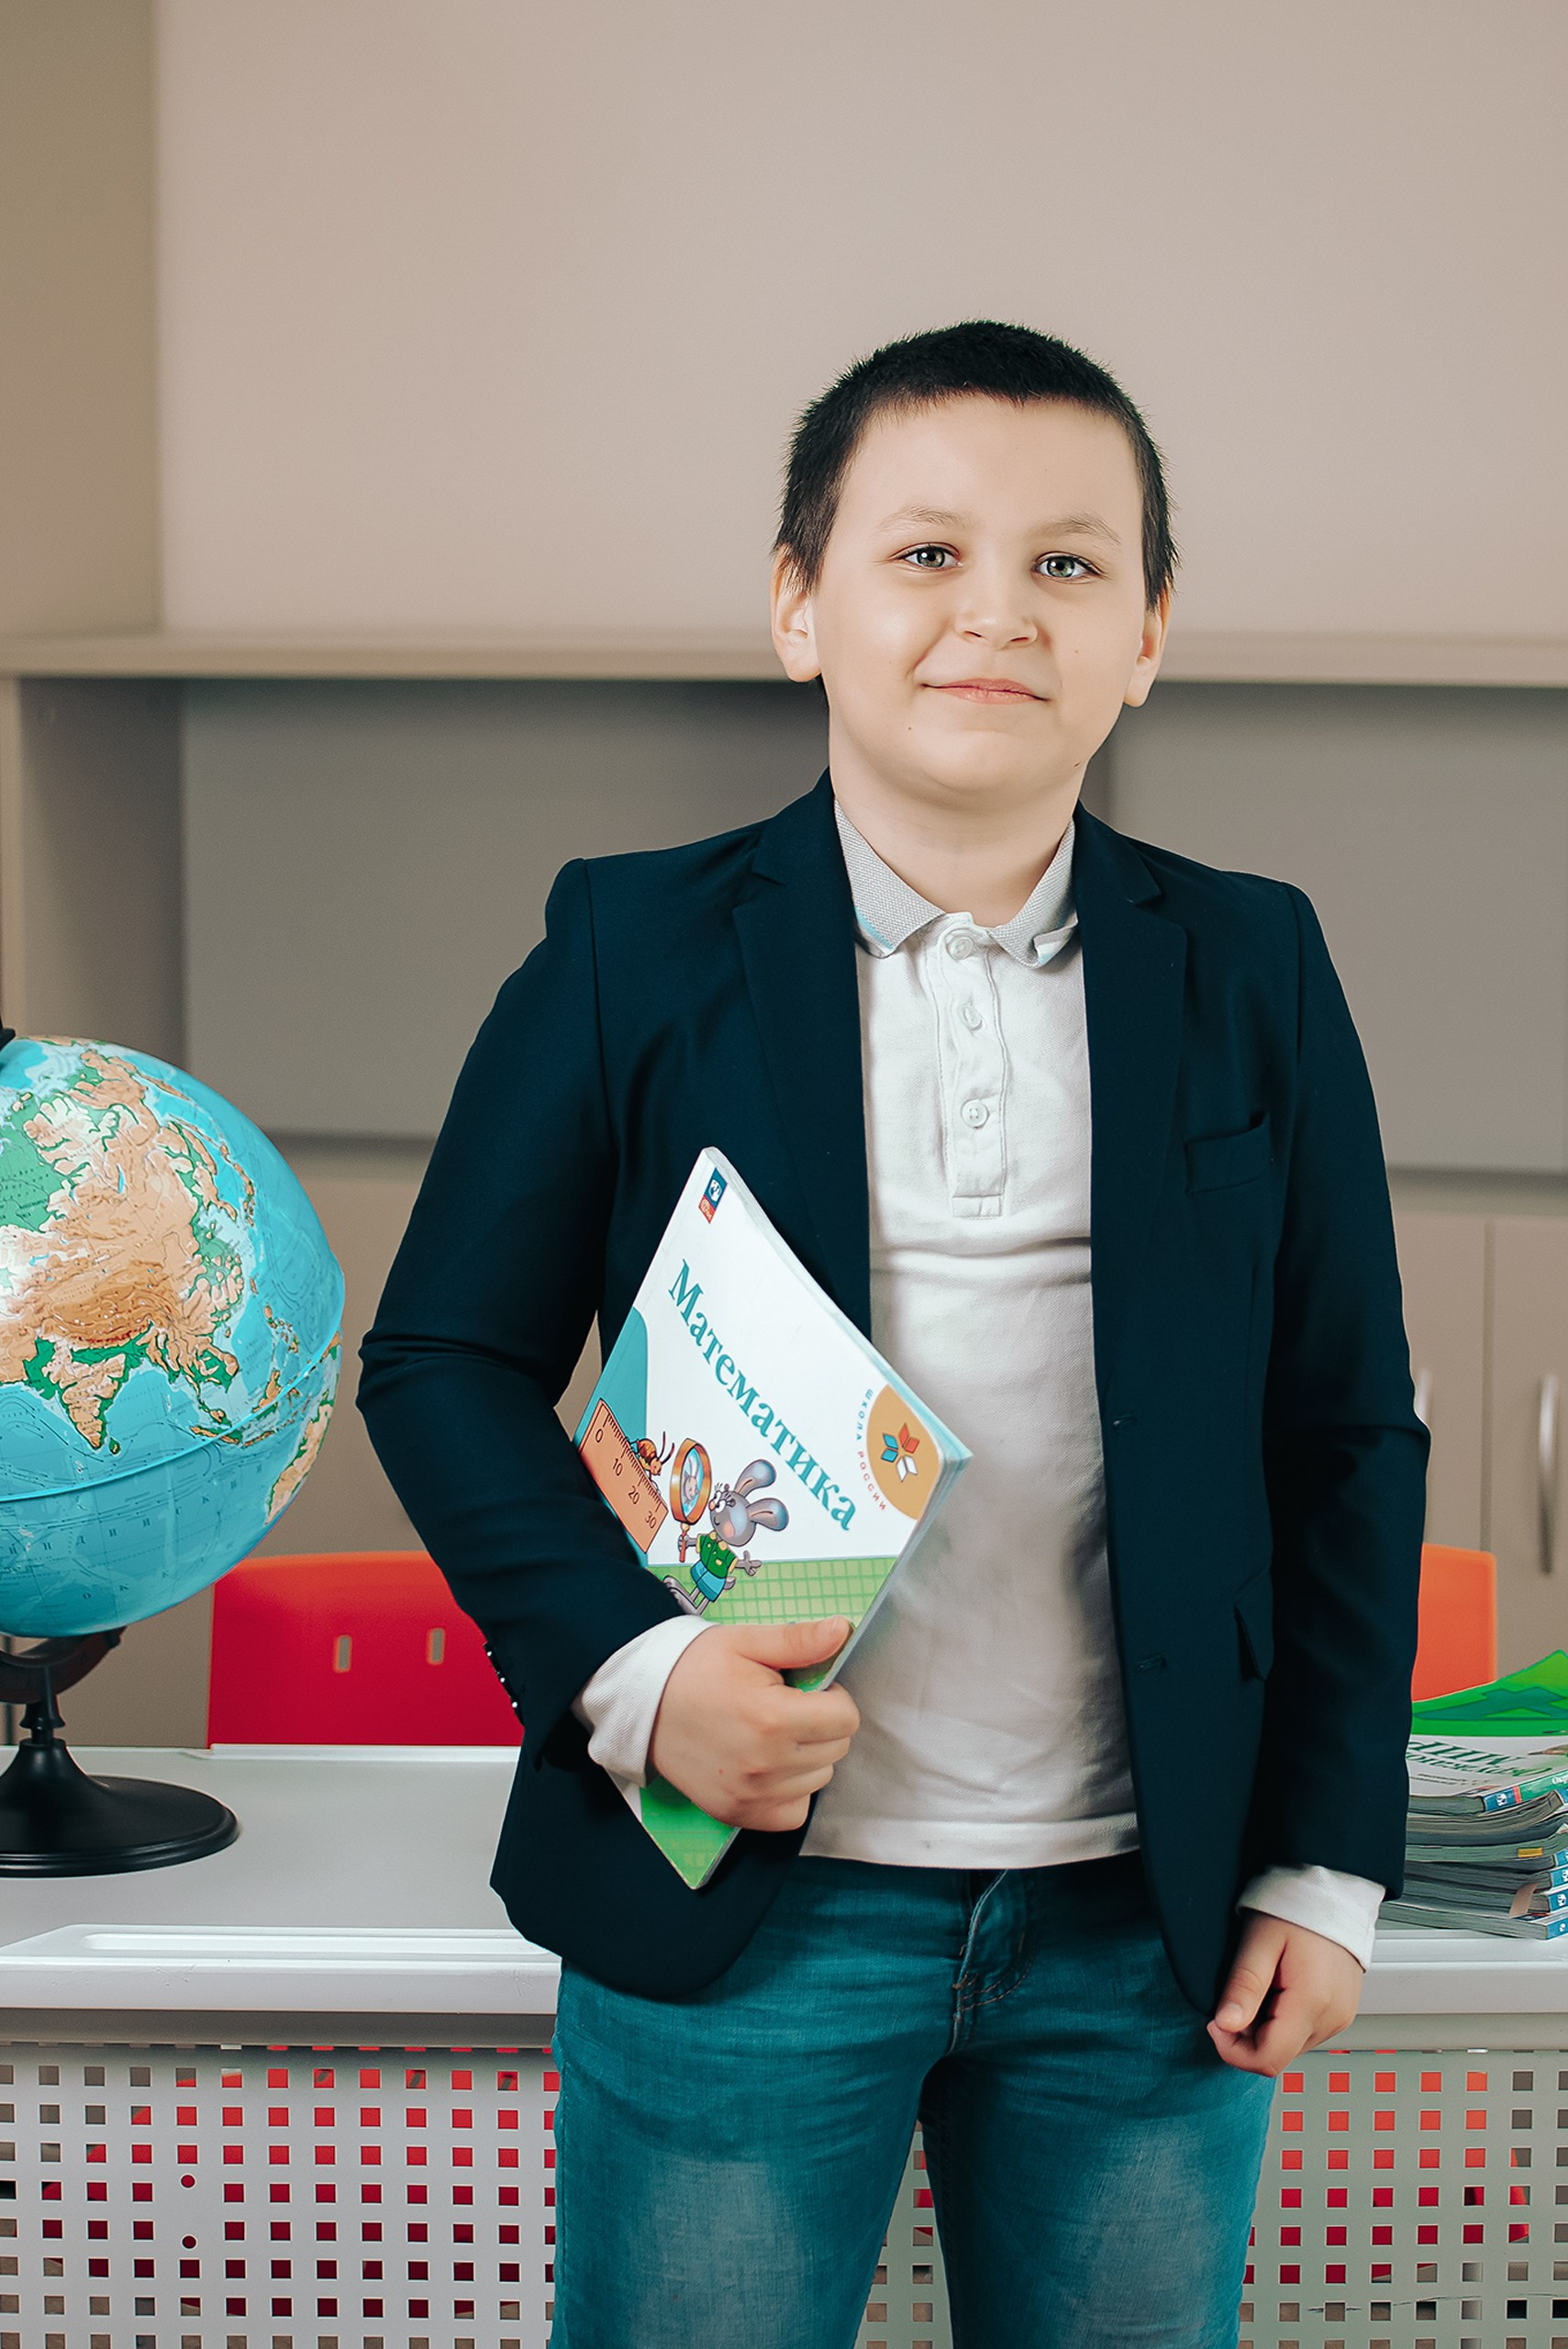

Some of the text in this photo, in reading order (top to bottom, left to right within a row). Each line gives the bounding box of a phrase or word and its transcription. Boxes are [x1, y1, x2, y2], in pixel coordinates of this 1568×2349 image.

[667, 1258, 857, 1531] Математика
[856, 1388, 886, 1510] ШКОЛА РОССИИ
[595, 1429, 657, 1529] 0 10 20 30
